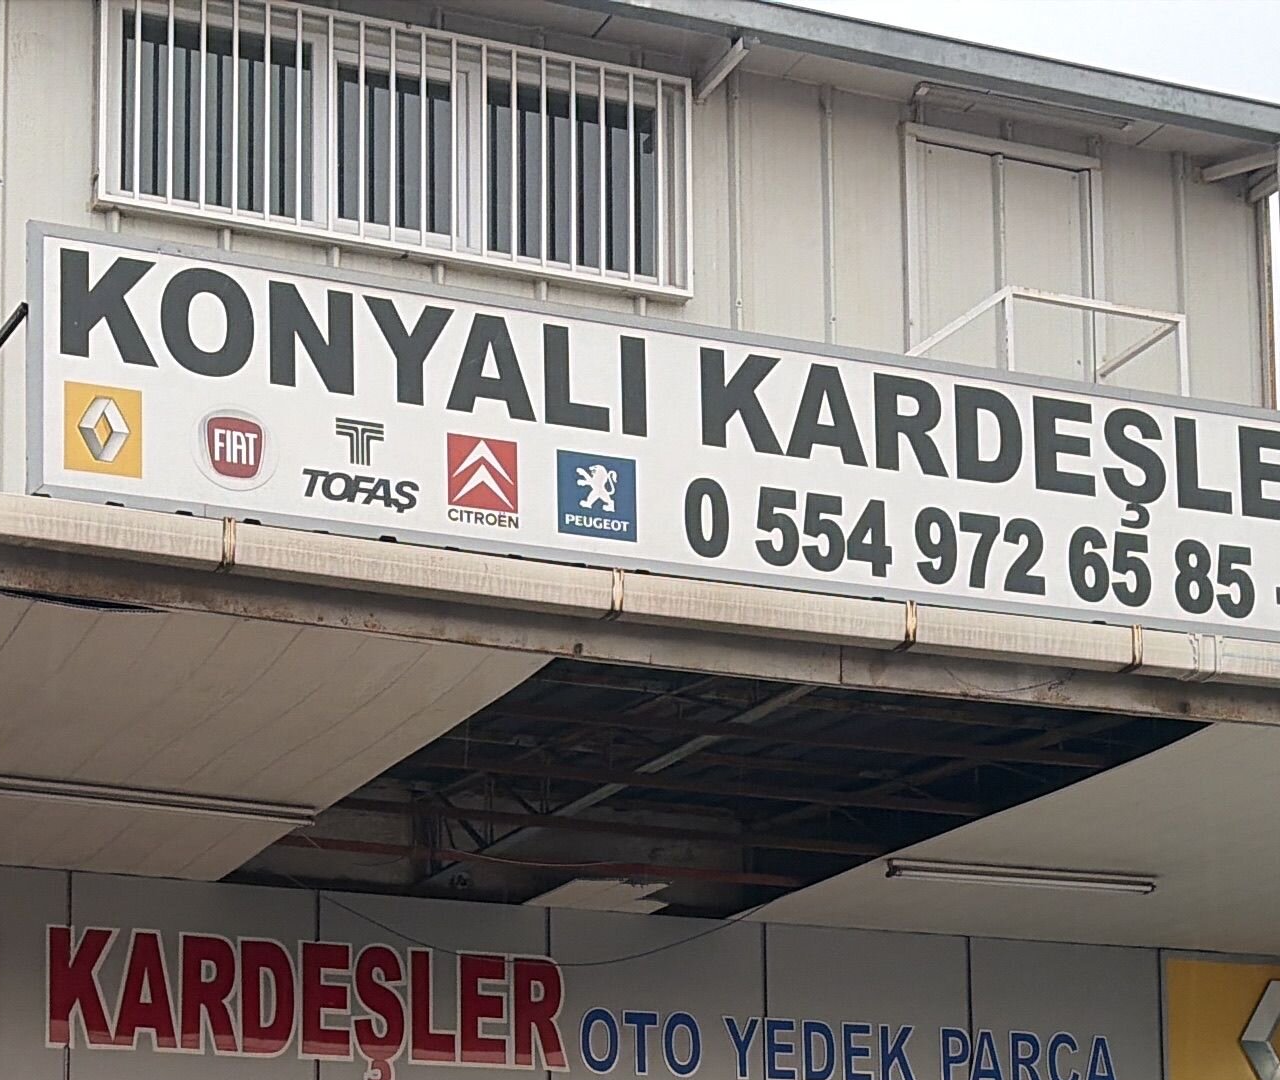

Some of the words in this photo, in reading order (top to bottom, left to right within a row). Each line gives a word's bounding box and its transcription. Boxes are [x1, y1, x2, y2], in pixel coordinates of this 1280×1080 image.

[60, 248, 648, 437] KONYALI
[214, 428, 258, 466] FIAT
[303, 468, 419, 512] TOFAŞ
[447, 507, 520, 530] CITROËN
[565, 513, 630, 533] PEUGEOT
[685, 478, 721, 558] 0
[756, 488, 892, 578] 554
[916, 505, 1045, 595] 972
[1069, 532, 1152, 607] 65
[1175, 540, 1255, 620] 85
[579, 1005, 702, 1080] OTO
